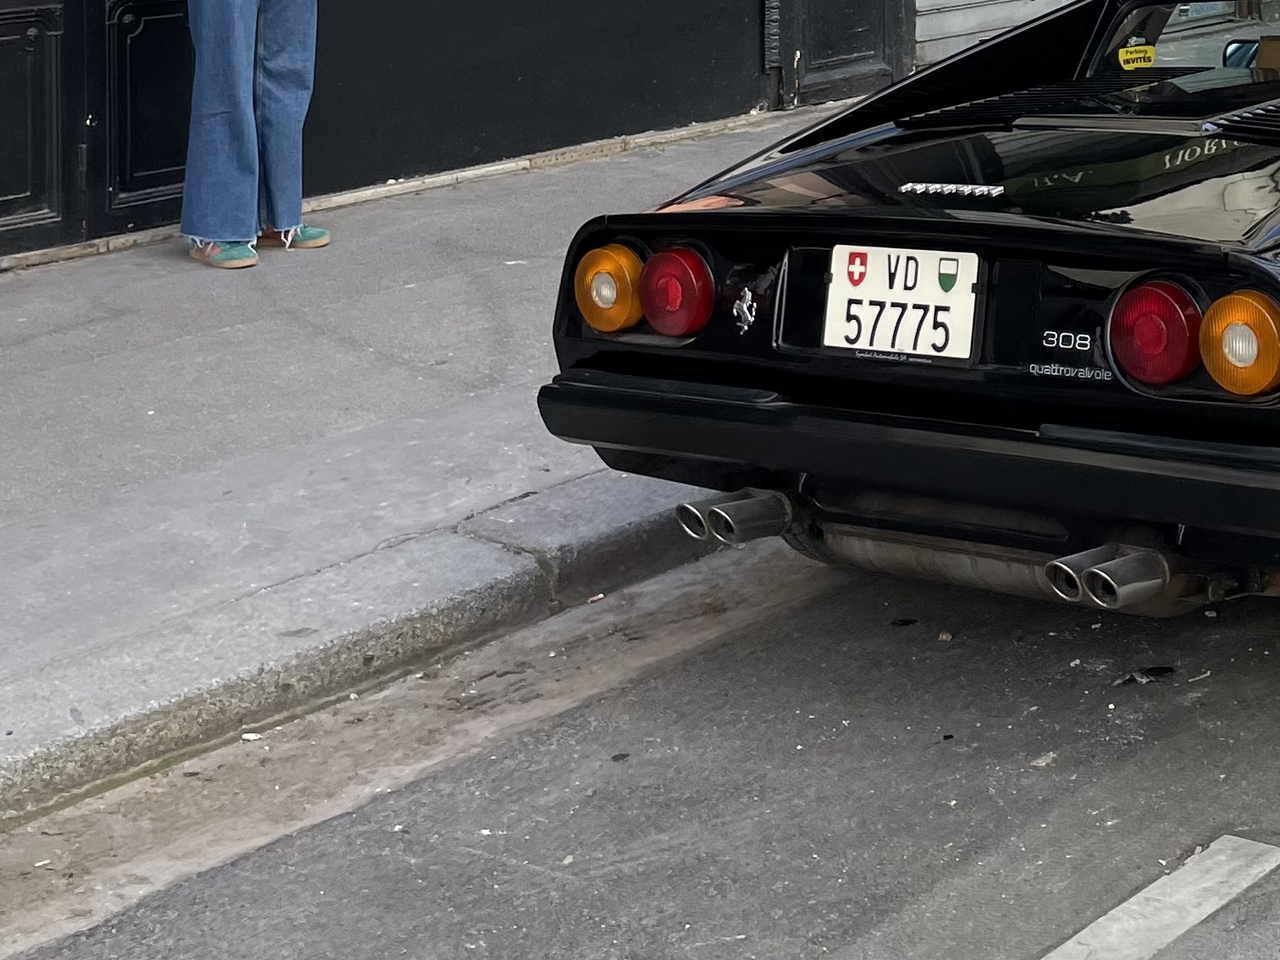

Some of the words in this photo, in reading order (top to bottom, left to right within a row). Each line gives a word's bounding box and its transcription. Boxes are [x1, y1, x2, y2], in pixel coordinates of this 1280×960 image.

[888, 253, 919, 291] VD
[844, 298, 951, 353] 57775
[1042, 330, 1091, 350] 308
[1029, 363, 1112, 380] quattrovalvole
